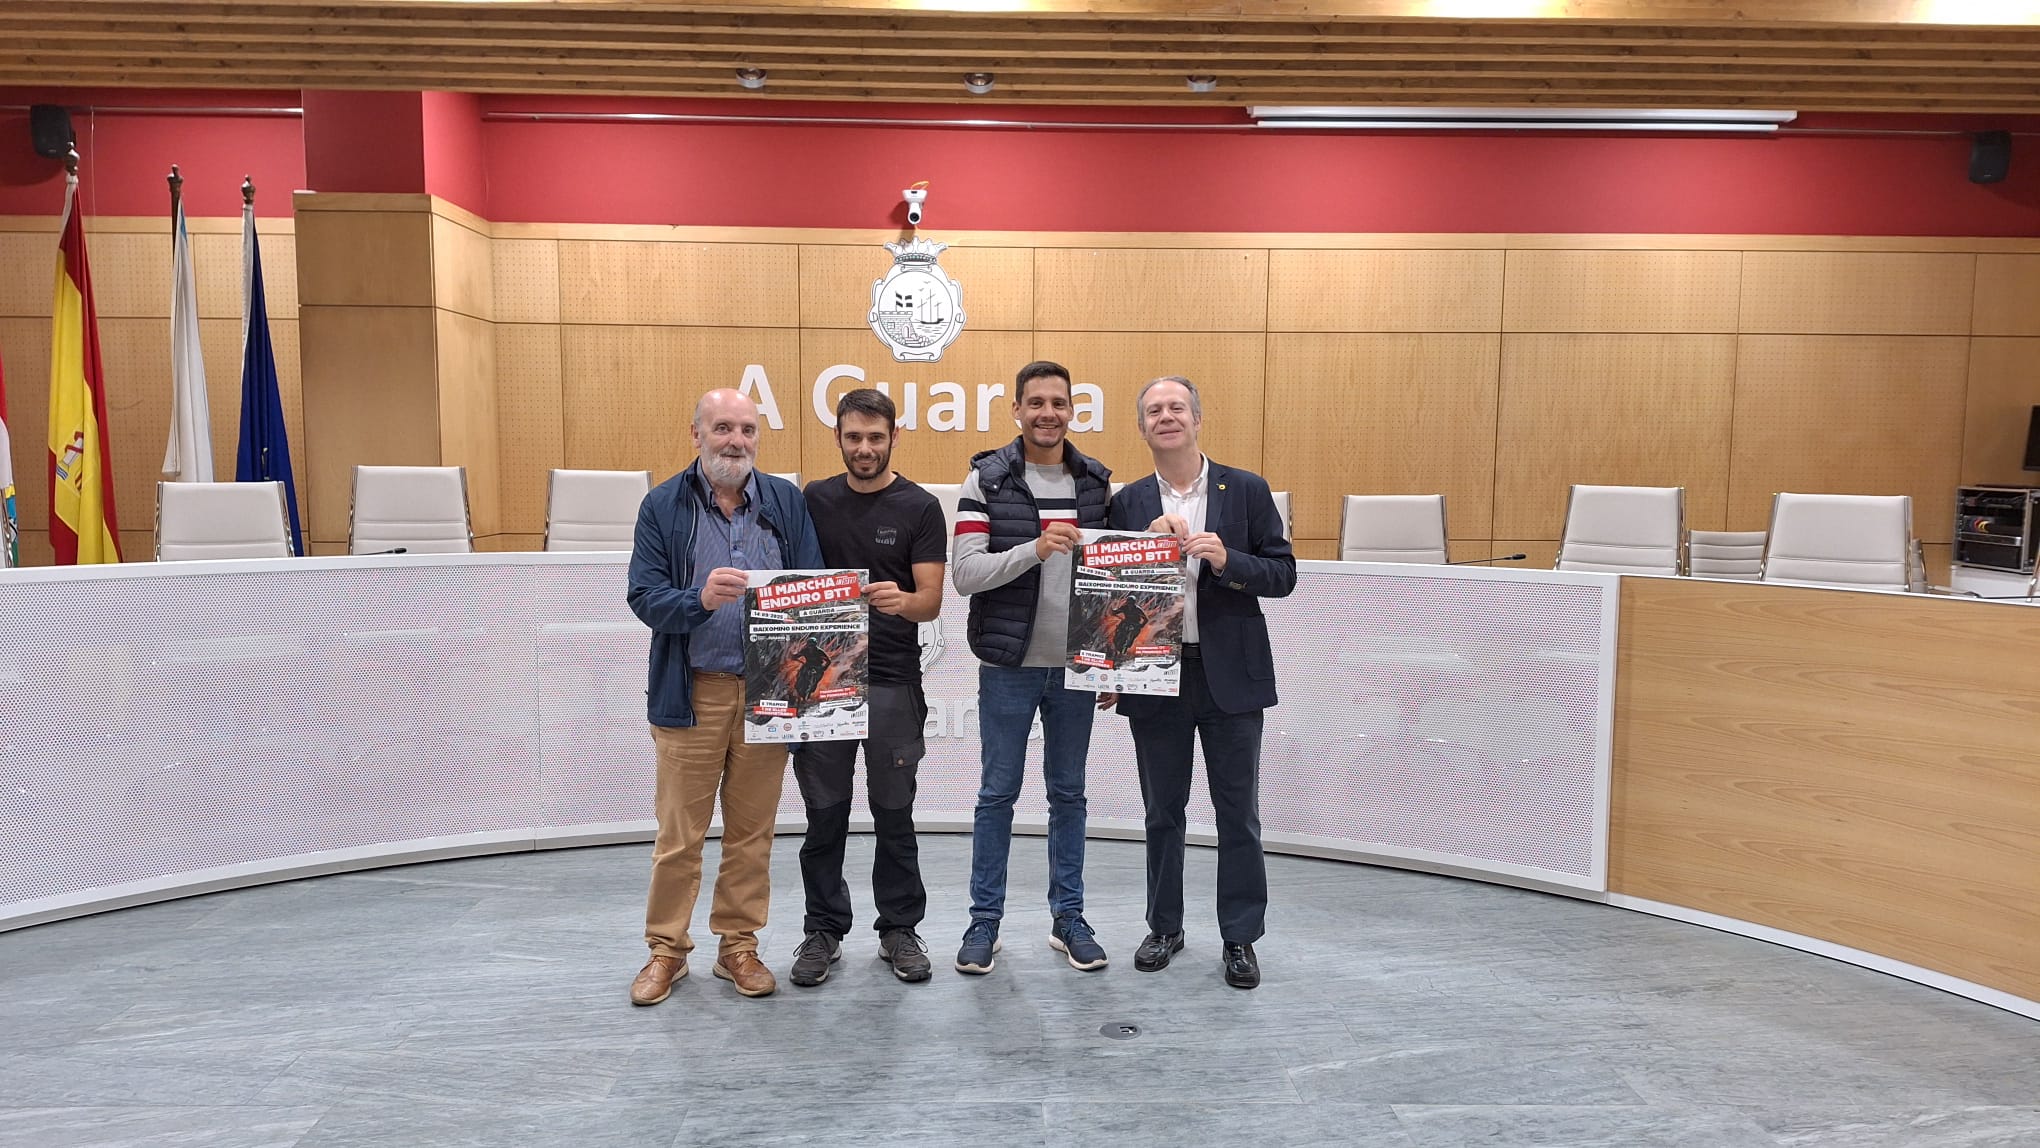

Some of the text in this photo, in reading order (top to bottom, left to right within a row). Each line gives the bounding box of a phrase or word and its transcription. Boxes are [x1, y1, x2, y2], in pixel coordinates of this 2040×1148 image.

[737, 364, 1104, 433] A Guara
[1085, 545, 1098, 555] III
[1100, 540, 1157, 554] MARCHA
[1086, 550, 1171, 566] ENDURO BTT
[758, 587, 773, 598] III
[775, 577, 837, 596] MARCHA
[760, 586, 852, 610] ENDURO BTT
